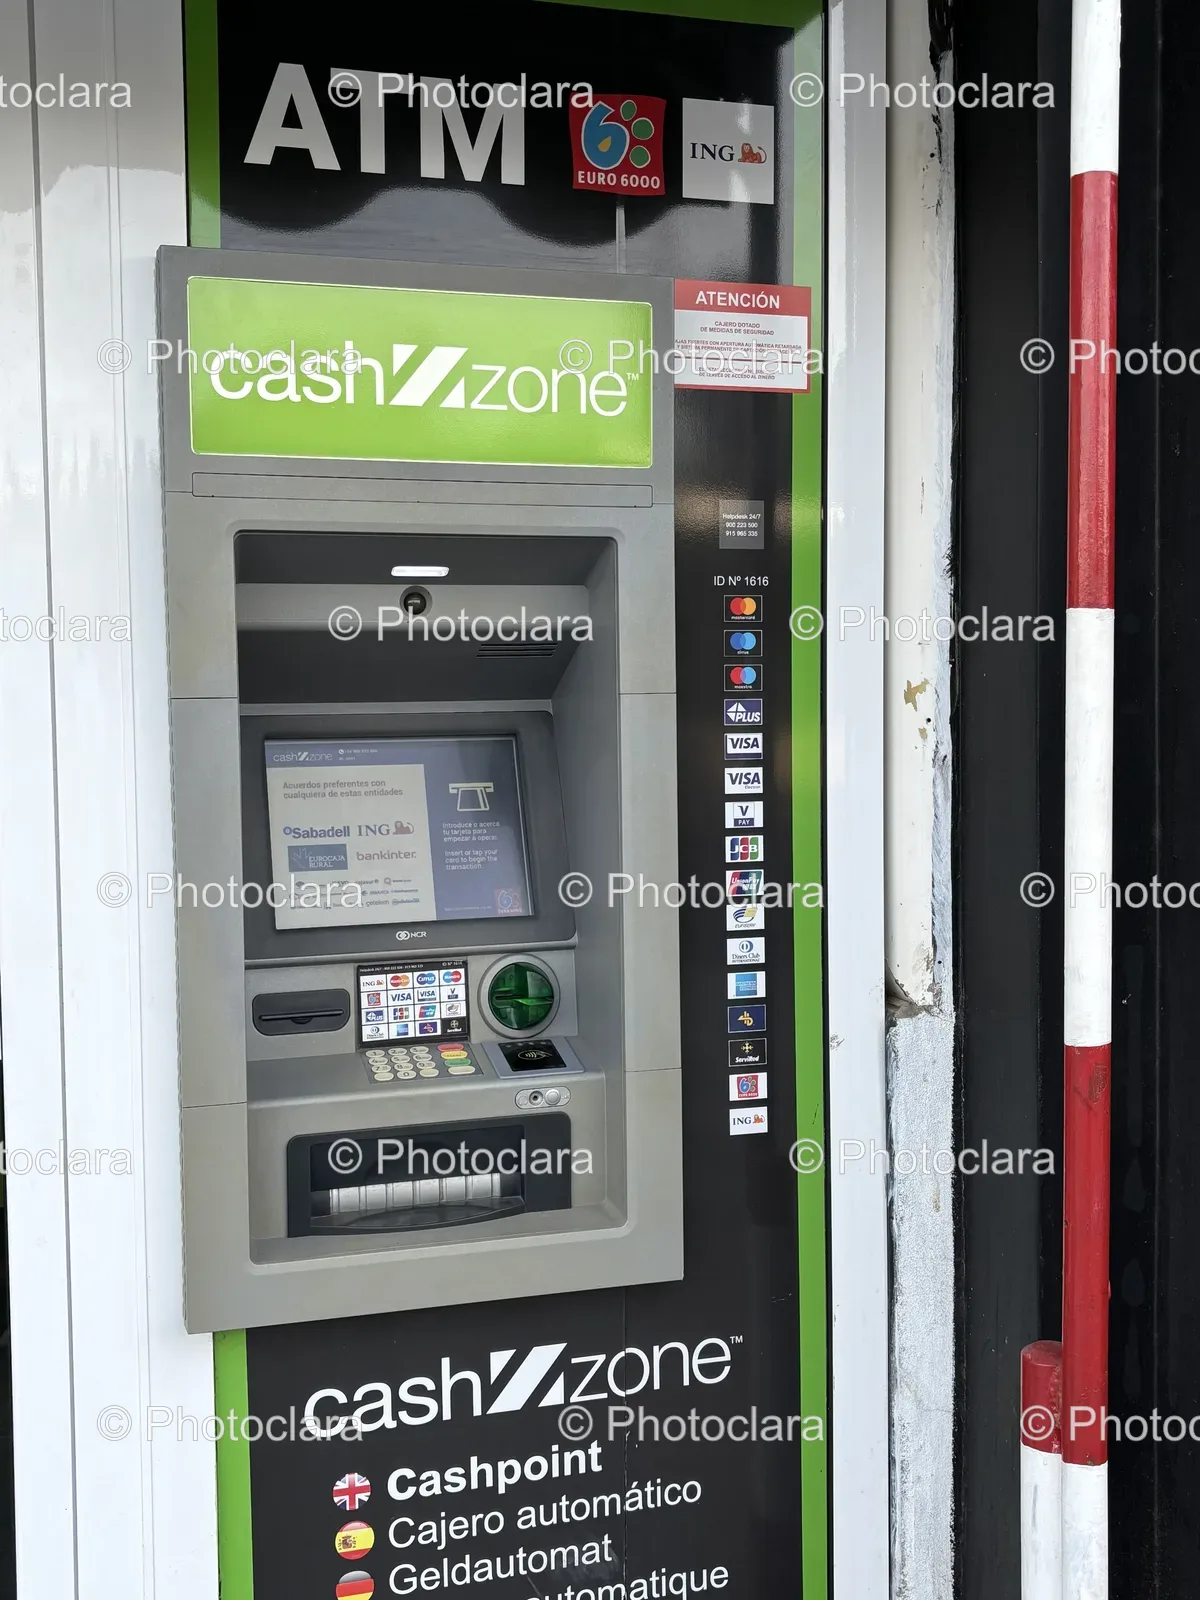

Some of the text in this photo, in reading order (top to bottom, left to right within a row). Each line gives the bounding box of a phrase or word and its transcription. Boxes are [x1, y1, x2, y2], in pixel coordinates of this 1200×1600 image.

[243, 62, 526, 186] ATM
[689, 142, 735, 162] ING
[577, 170, 661, 190] EURO 6000
[695, 290, 781, 310] ATENCIÓN
[714, 320, 761, 329] CAJERO DOTADO
[708, 326, 734, 334] MEDIDAS
[743, 328, 775, 336] SEGURIDAD
[722, 513, 762, 521] Helpdesk 24/7
[713, 575, 725, 586] ID
[744, 575, 769, 587] 1616
[735, 711, 761, 723] PLUS
[727, 737, 760, 749] VISA
[726, 772, 761, 785] VISA
[282, 781, 321, 790] Acuerdos
[323, 779, 369, 790] preferentes
[283, 790, 327, 800] cualquiera
[328, 789, 338, 798] de
[363, 787, 403, 797] entidades
[357, 823, 391, 837] ING
[442, 821, 473, 829] Introduce
[291, 825, 351, 839] Sabadell
[450, 828, 472, 836] tarjeta
[472, 828, 487, 836] para
[444, 849, 464, 857] Insert
[472, 849, 484, 857] tap
[483, 848, 499, 857] your
[730, 844, 758, 853] JCB
[308, 855, 346, 864] EUROCAJA
[308, 861, 334, 869] RURAL
[468, 856, 486, 864] begin
[390, 993, 412, 1002] VISA
[420, 990, 436, 998] VISA
[734, 1055, 760, 1064] ServiRed
[732, 1116, 752, 1126] ING
[386, 1439, 603, 1502] Cashpoint
[388, 1478, 702, 1551] Cajero automático
[388, 1532, 613, 1597] Geldautomat
